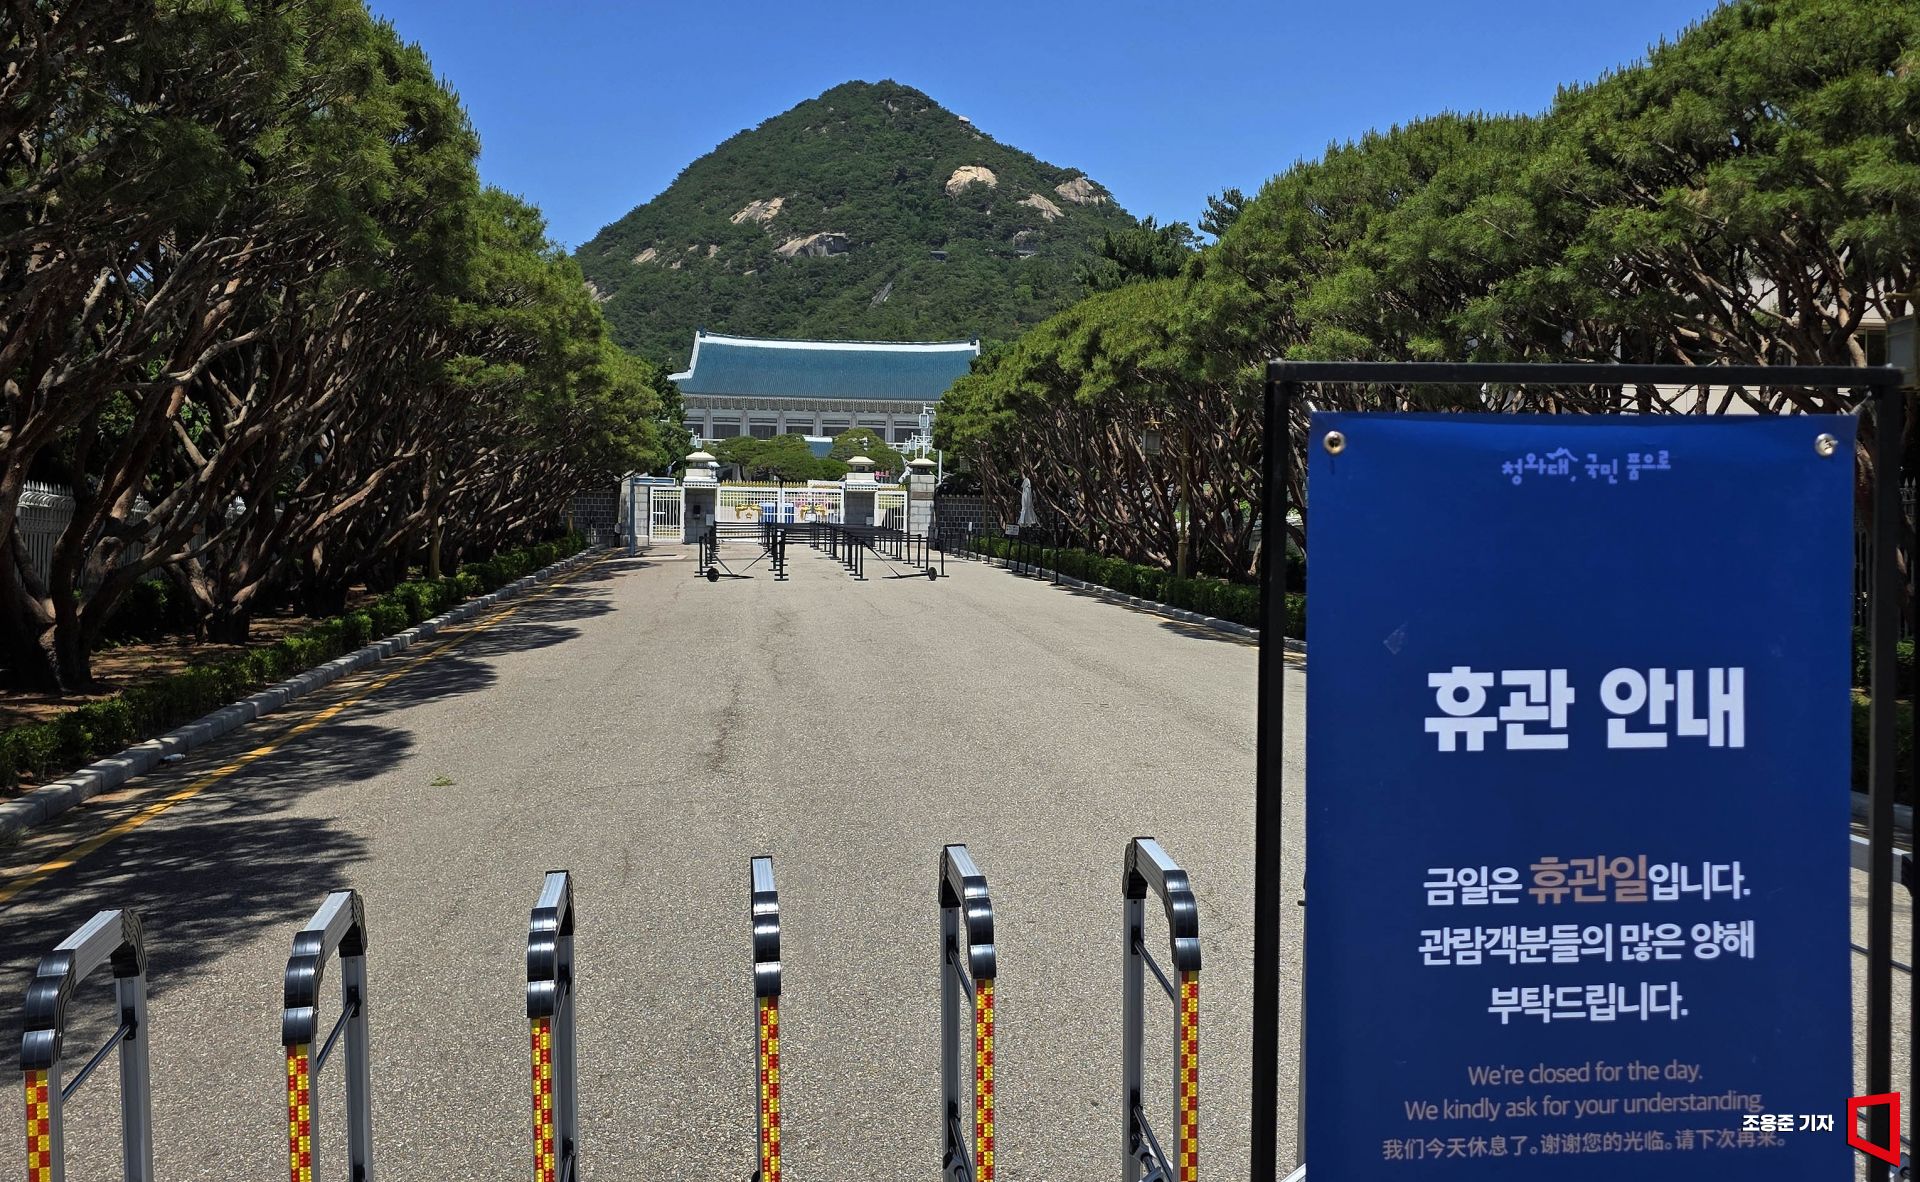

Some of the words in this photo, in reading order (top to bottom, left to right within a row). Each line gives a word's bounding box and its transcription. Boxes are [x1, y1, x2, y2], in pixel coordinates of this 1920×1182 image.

[1585, 453, 1618, 484] 국민
[1626, 450, 1671, 480] 품으로
[1424, 666, 1575, 752] 휴관
[1600, 667, 1745, 748] 안내
[1423, 866, 1523, 905] 금일은
[1528, 854, 1751, 904] 휴관일입니다.
[1418, 922, 1613, 965] 관람객분들의
[1620, 922, 1686, 962] 많은
[1690, 920, 1755, 960] 양해
[1488, 981, 1689, 1025] 부탁드립니다.
[1468, 1064, 1524, 1086] We're
[1528, 1062, 1590, 1084] closed
[1594, 1060, 1623, 1082] for
[1627, 1060, 1660, 1082] the
[1664, 1059, 1703, 1083] day.
[1404, 1100, 1438, 1121] We
[1443, 1097, 1501, 1122] kindly
[1505, 1096, 1538, 1118] ask
[1542, 1095, 1570, 1116] for
[1574, 1097, 1619, 1119] your
